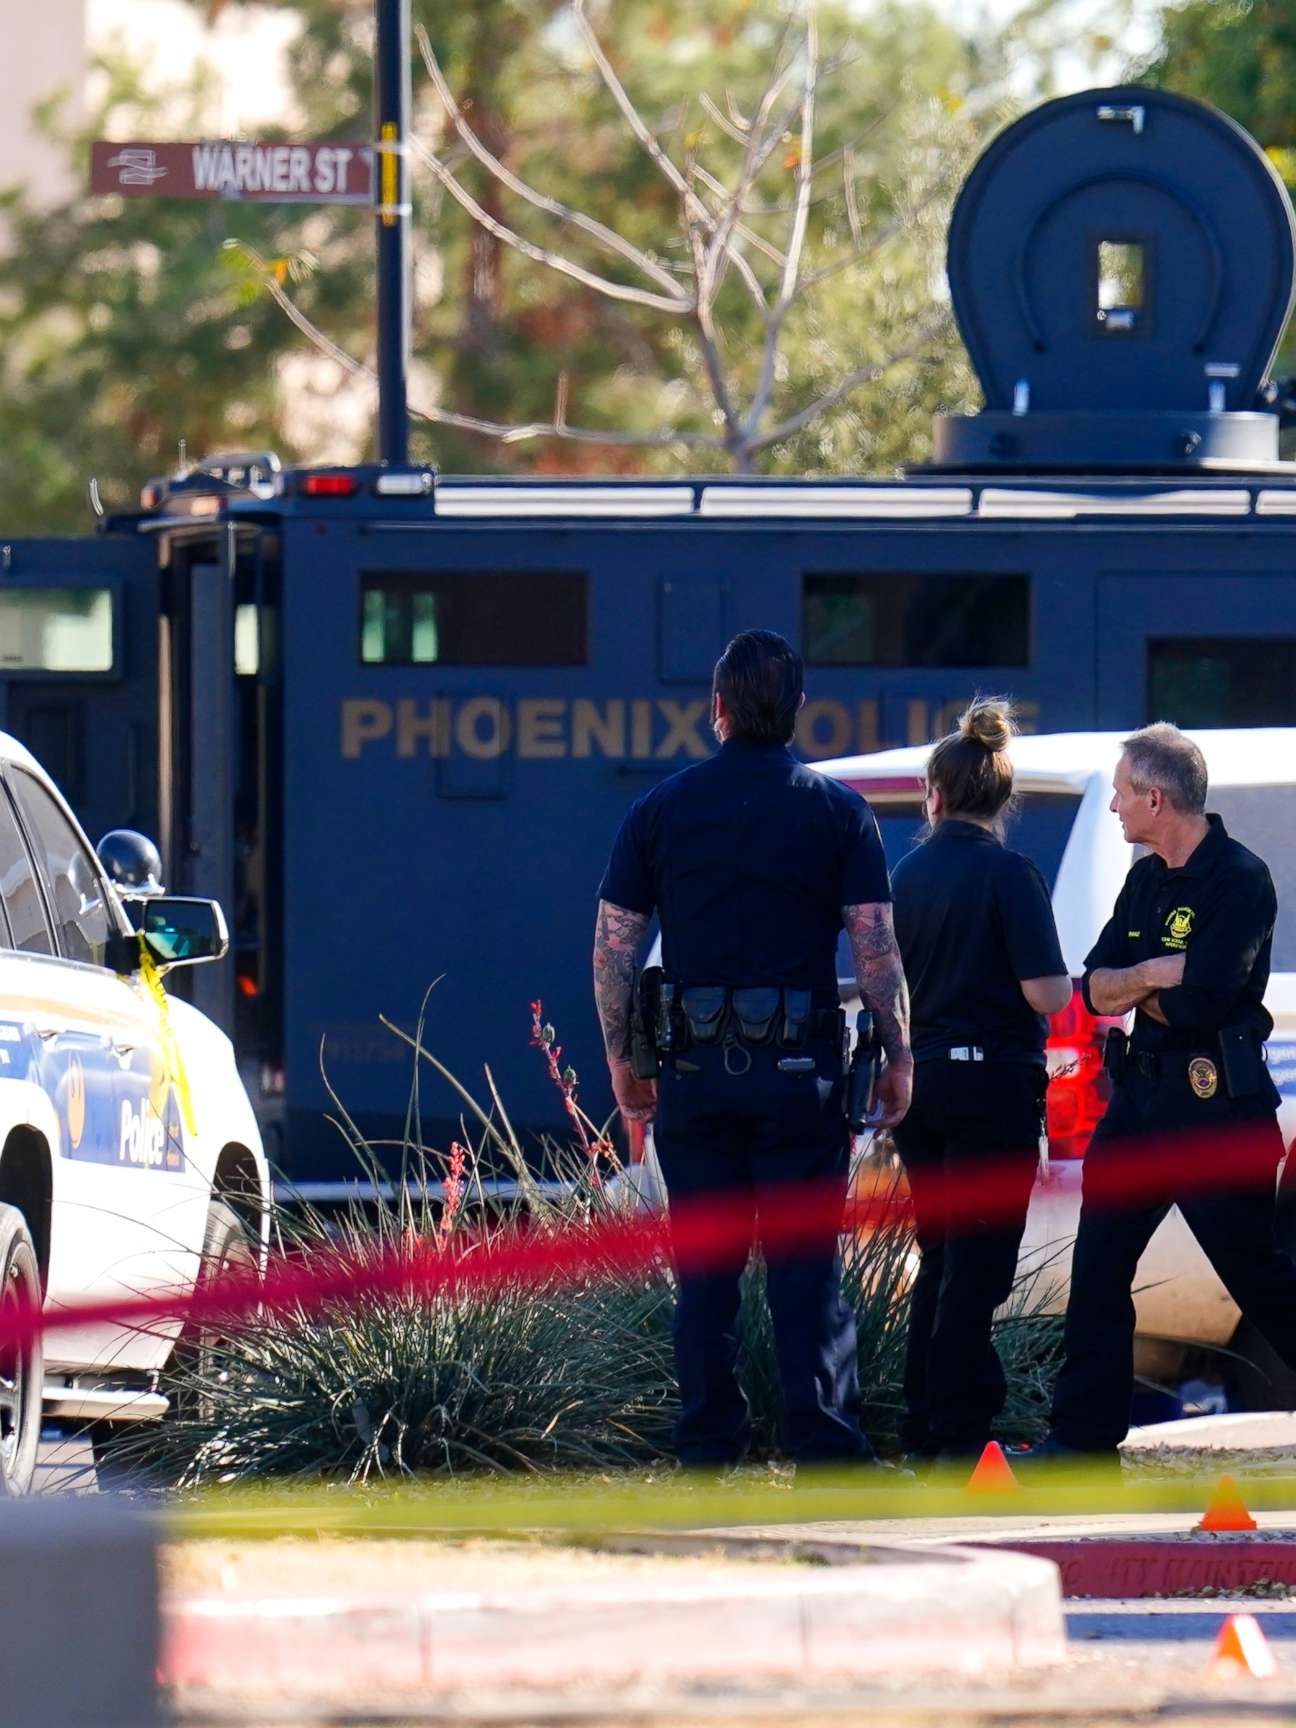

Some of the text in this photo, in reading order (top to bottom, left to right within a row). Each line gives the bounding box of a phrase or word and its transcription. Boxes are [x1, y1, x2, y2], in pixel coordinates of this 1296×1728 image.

[193, 145, 352, 192] WARNER ST
[341, 698, 710, 760] PHOENIX
[120, 1097, 165, 1165] Police
